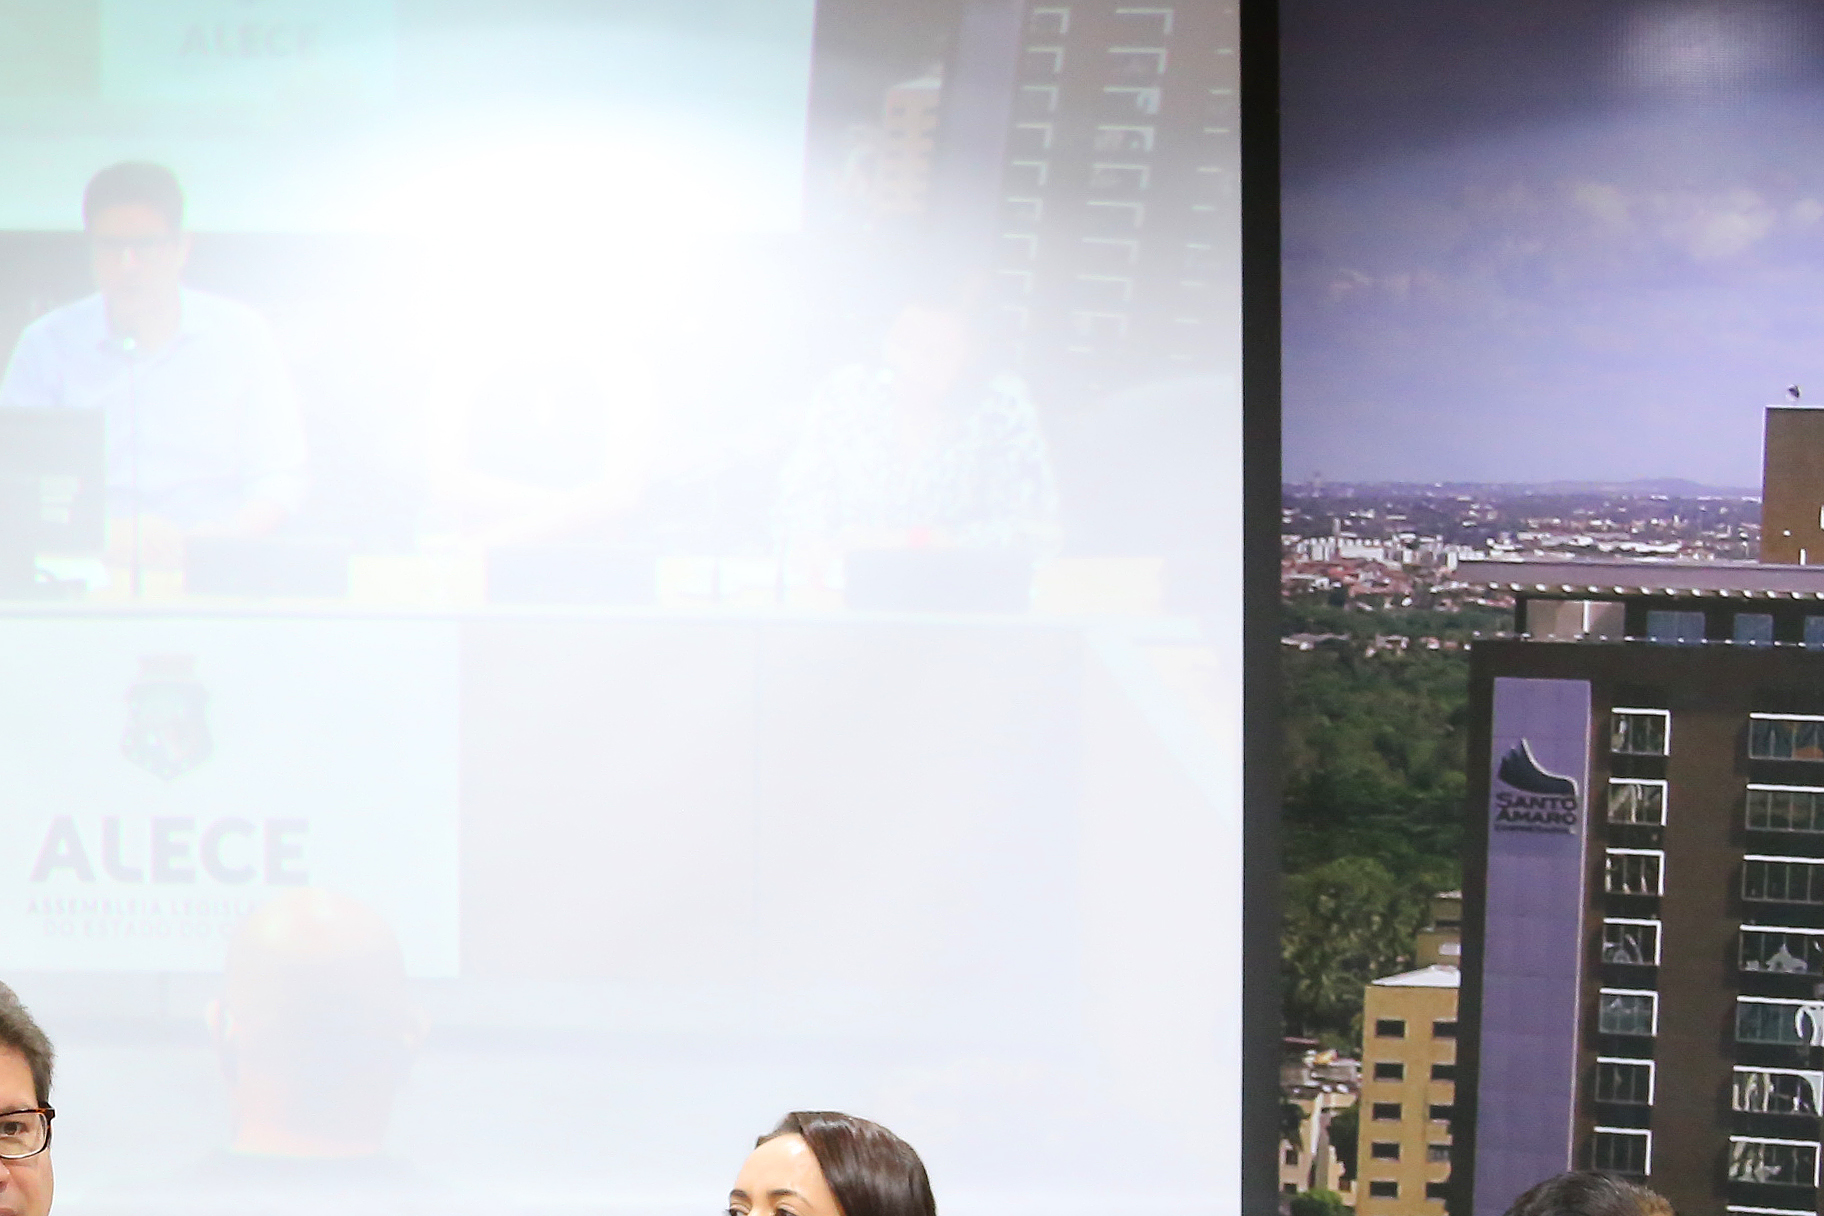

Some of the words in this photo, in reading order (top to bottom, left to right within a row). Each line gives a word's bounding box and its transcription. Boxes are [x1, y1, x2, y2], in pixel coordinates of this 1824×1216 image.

[1496, 792, 1577, 810] SANTO
[1496, 807, 1577, 825] AMARO
[30, 816, 310, 886] ALECE
[27, 898, 162, 917] ASSEMBLEIA
[83, 920, 172, 939] ESTADO
